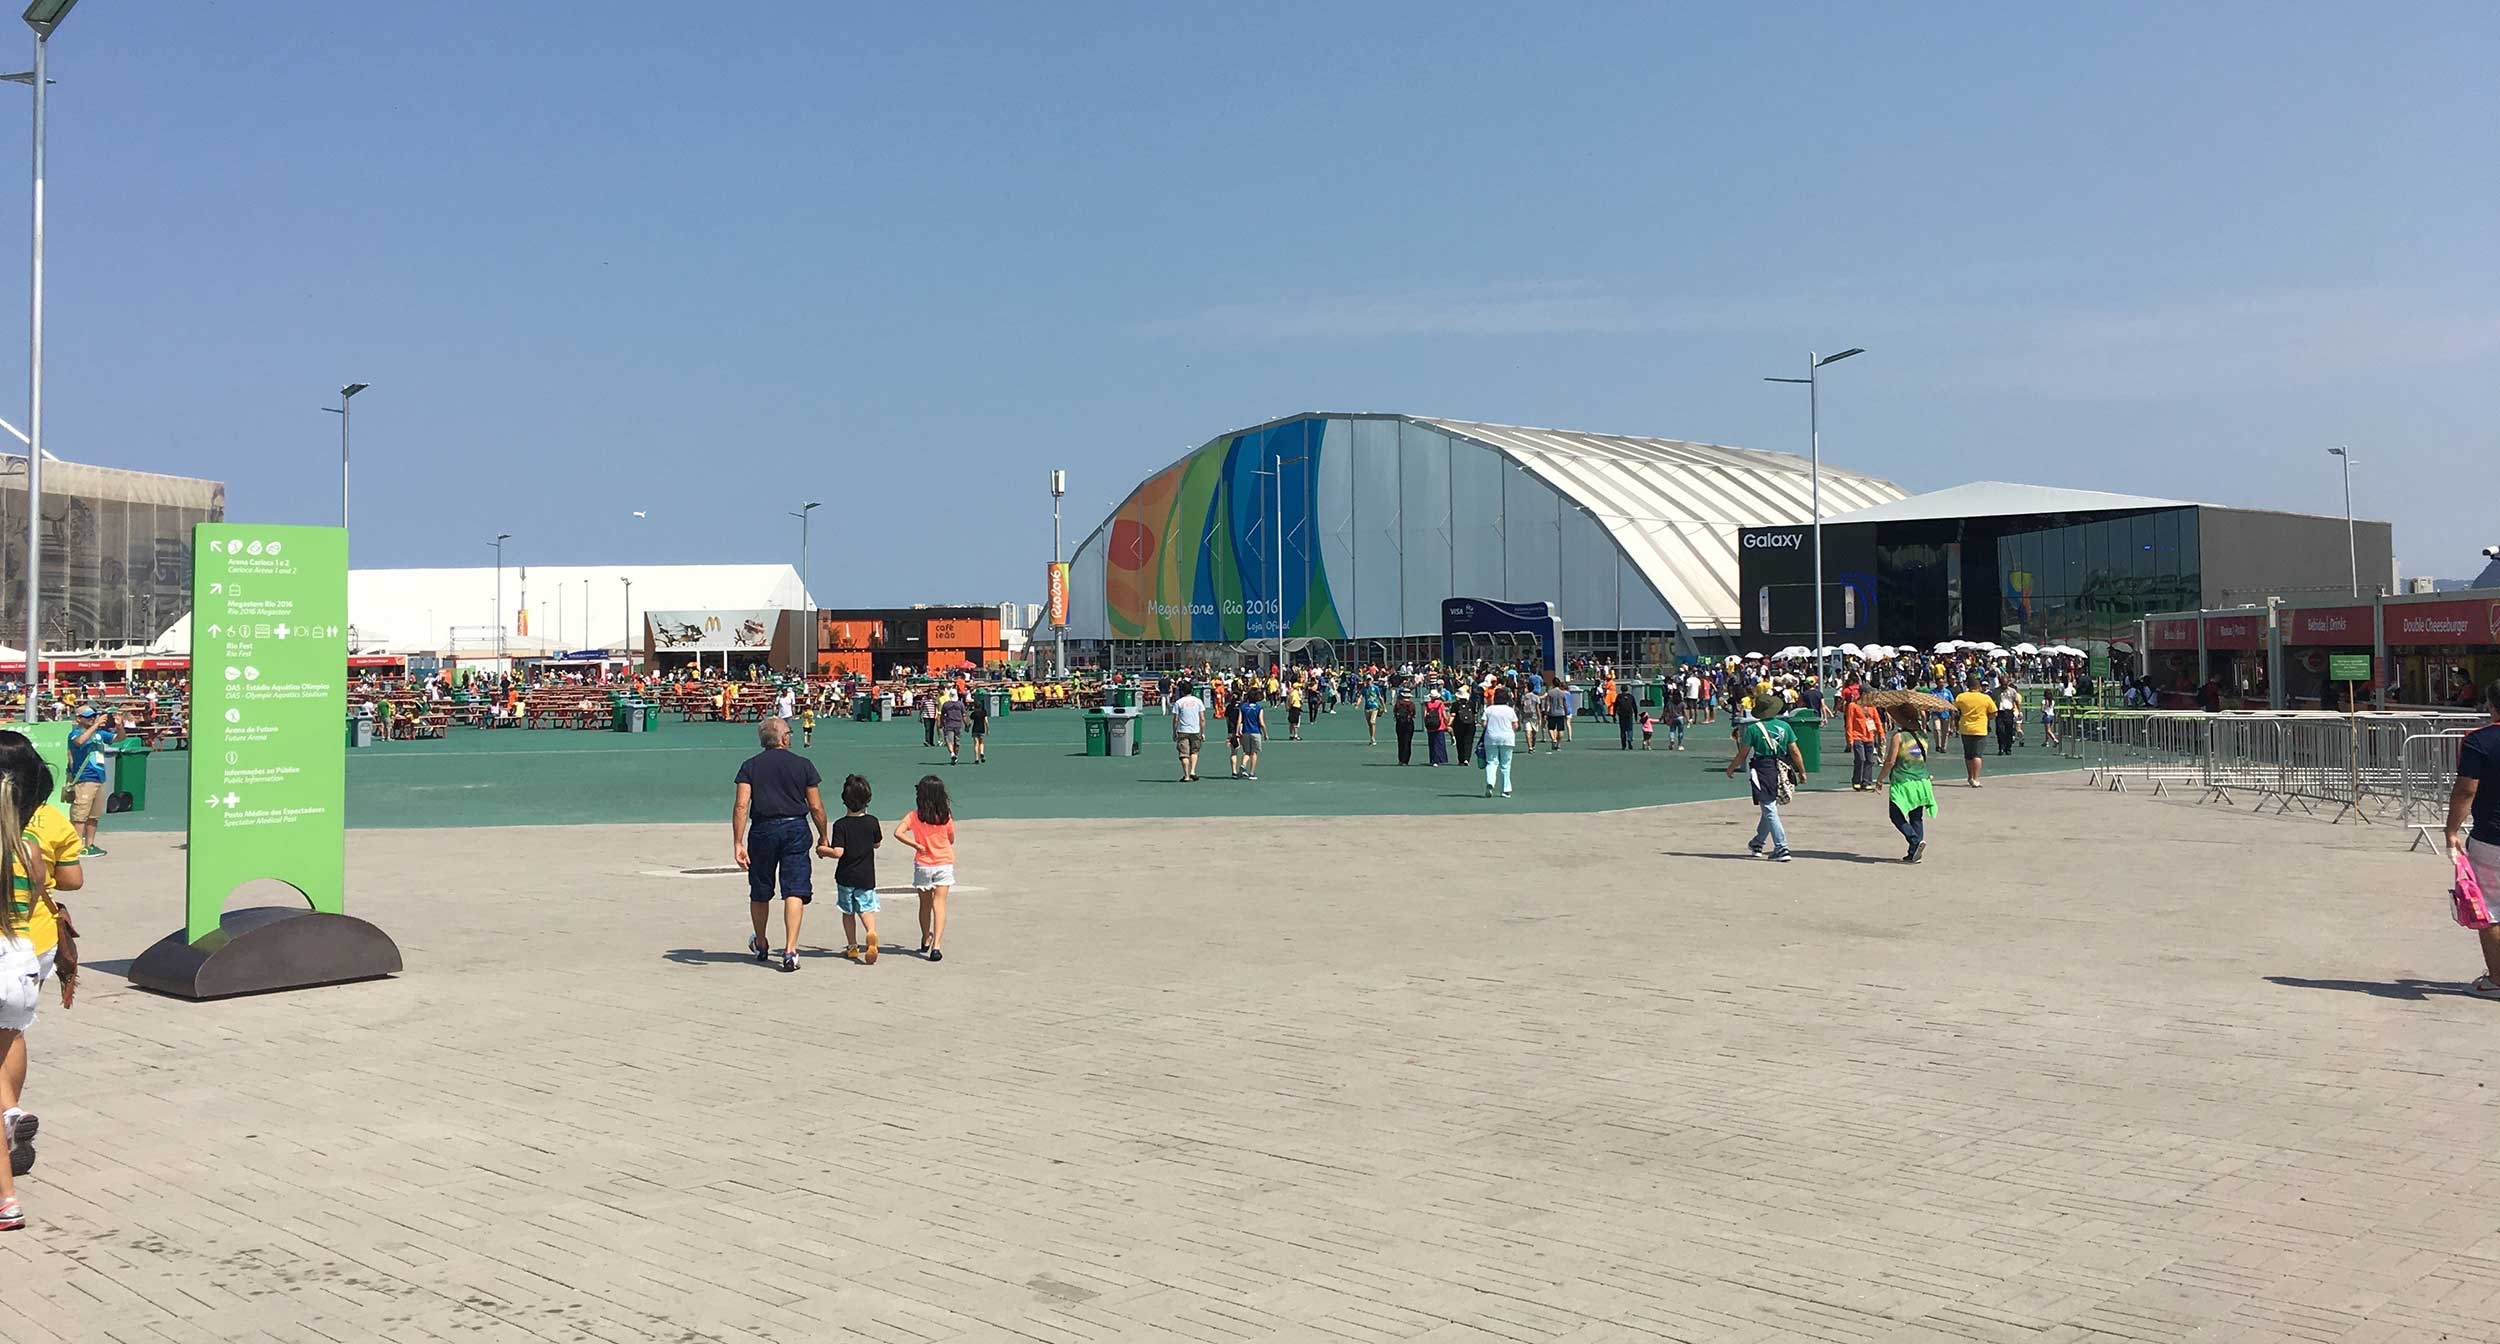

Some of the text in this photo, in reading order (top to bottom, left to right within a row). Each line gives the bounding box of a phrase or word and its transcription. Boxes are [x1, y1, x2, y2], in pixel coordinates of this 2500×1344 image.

[1743, 533, 1803, 550] Galaxy
[1147, 599, 1279, 620] Megastore Rio 2016
[1449, 608, 1464, 616] VISA
[1246, 620, 1290, 633] Loja Ofial
[2403, 617, 2468, 636] Double Cheeseburger
[238, 642, 253, 650] Fest
[245, 692, 271, 701] Olympic
[272, 692, 301, 701] Aquatics
[245, 776, 284, 784] Information
[283, 807, 325, 816] Espectadores
[224, 818, 256, 827] Spectator
[256, 816, 283, 824] Medical
